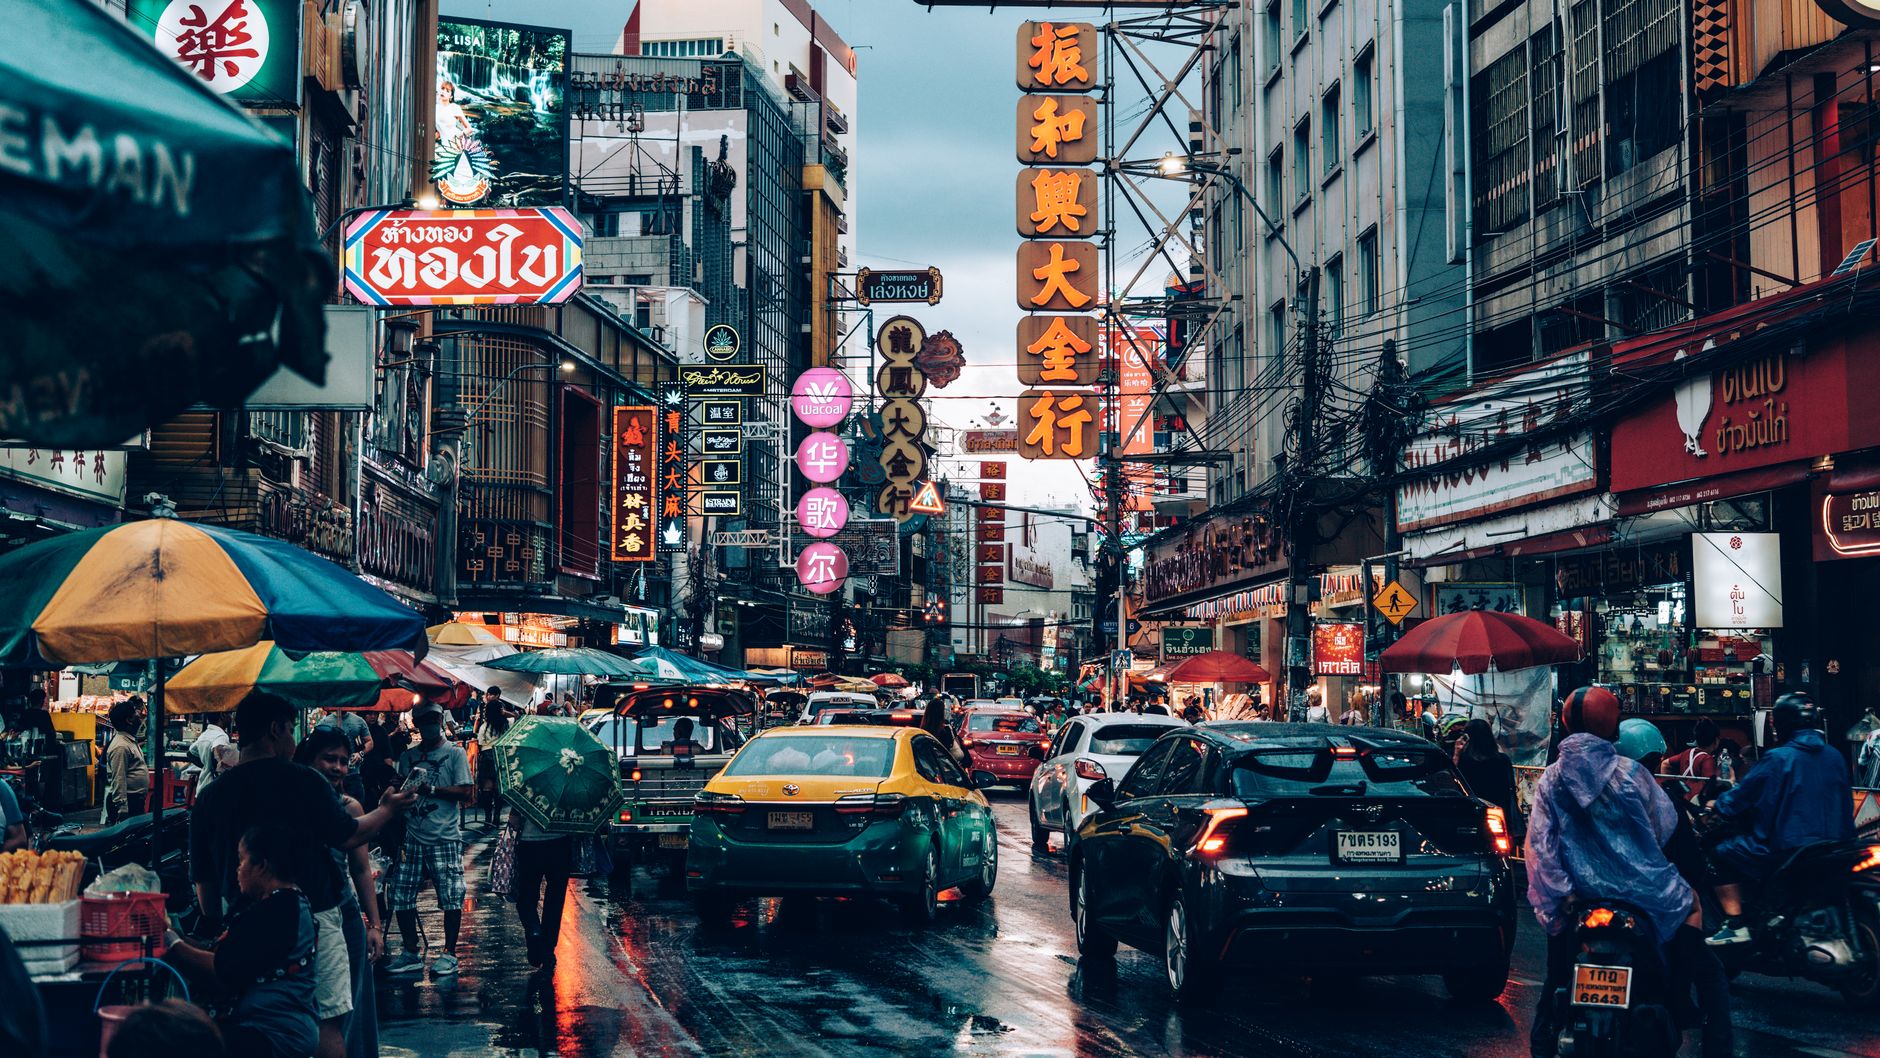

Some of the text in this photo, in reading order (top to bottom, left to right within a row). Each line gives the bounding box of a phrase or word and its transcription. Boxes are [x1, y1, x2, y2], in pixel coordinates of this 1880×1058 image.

[454, 34, 481, 46] LISA
[381, 219, 474, 243] ห้างทอง
[1026, 23, 1093, 457] 振和興大金行
[368, 223, 558, 289] ทองใบ
[870, 281, 928, 298] เล่งหงษ์
[709, 407, 734, 419] 温室
[801, 404, 844, 416] Wacoal
[884, 326, 916, 515] 龍鳳大金行
[1717, 398, 1786, 453] ข้าวมันไก่
[618, 493, 648, 552] 林真香
[806, 442, 838, 584] 华歌尔
[1129, 622, 1135, 630] 6
